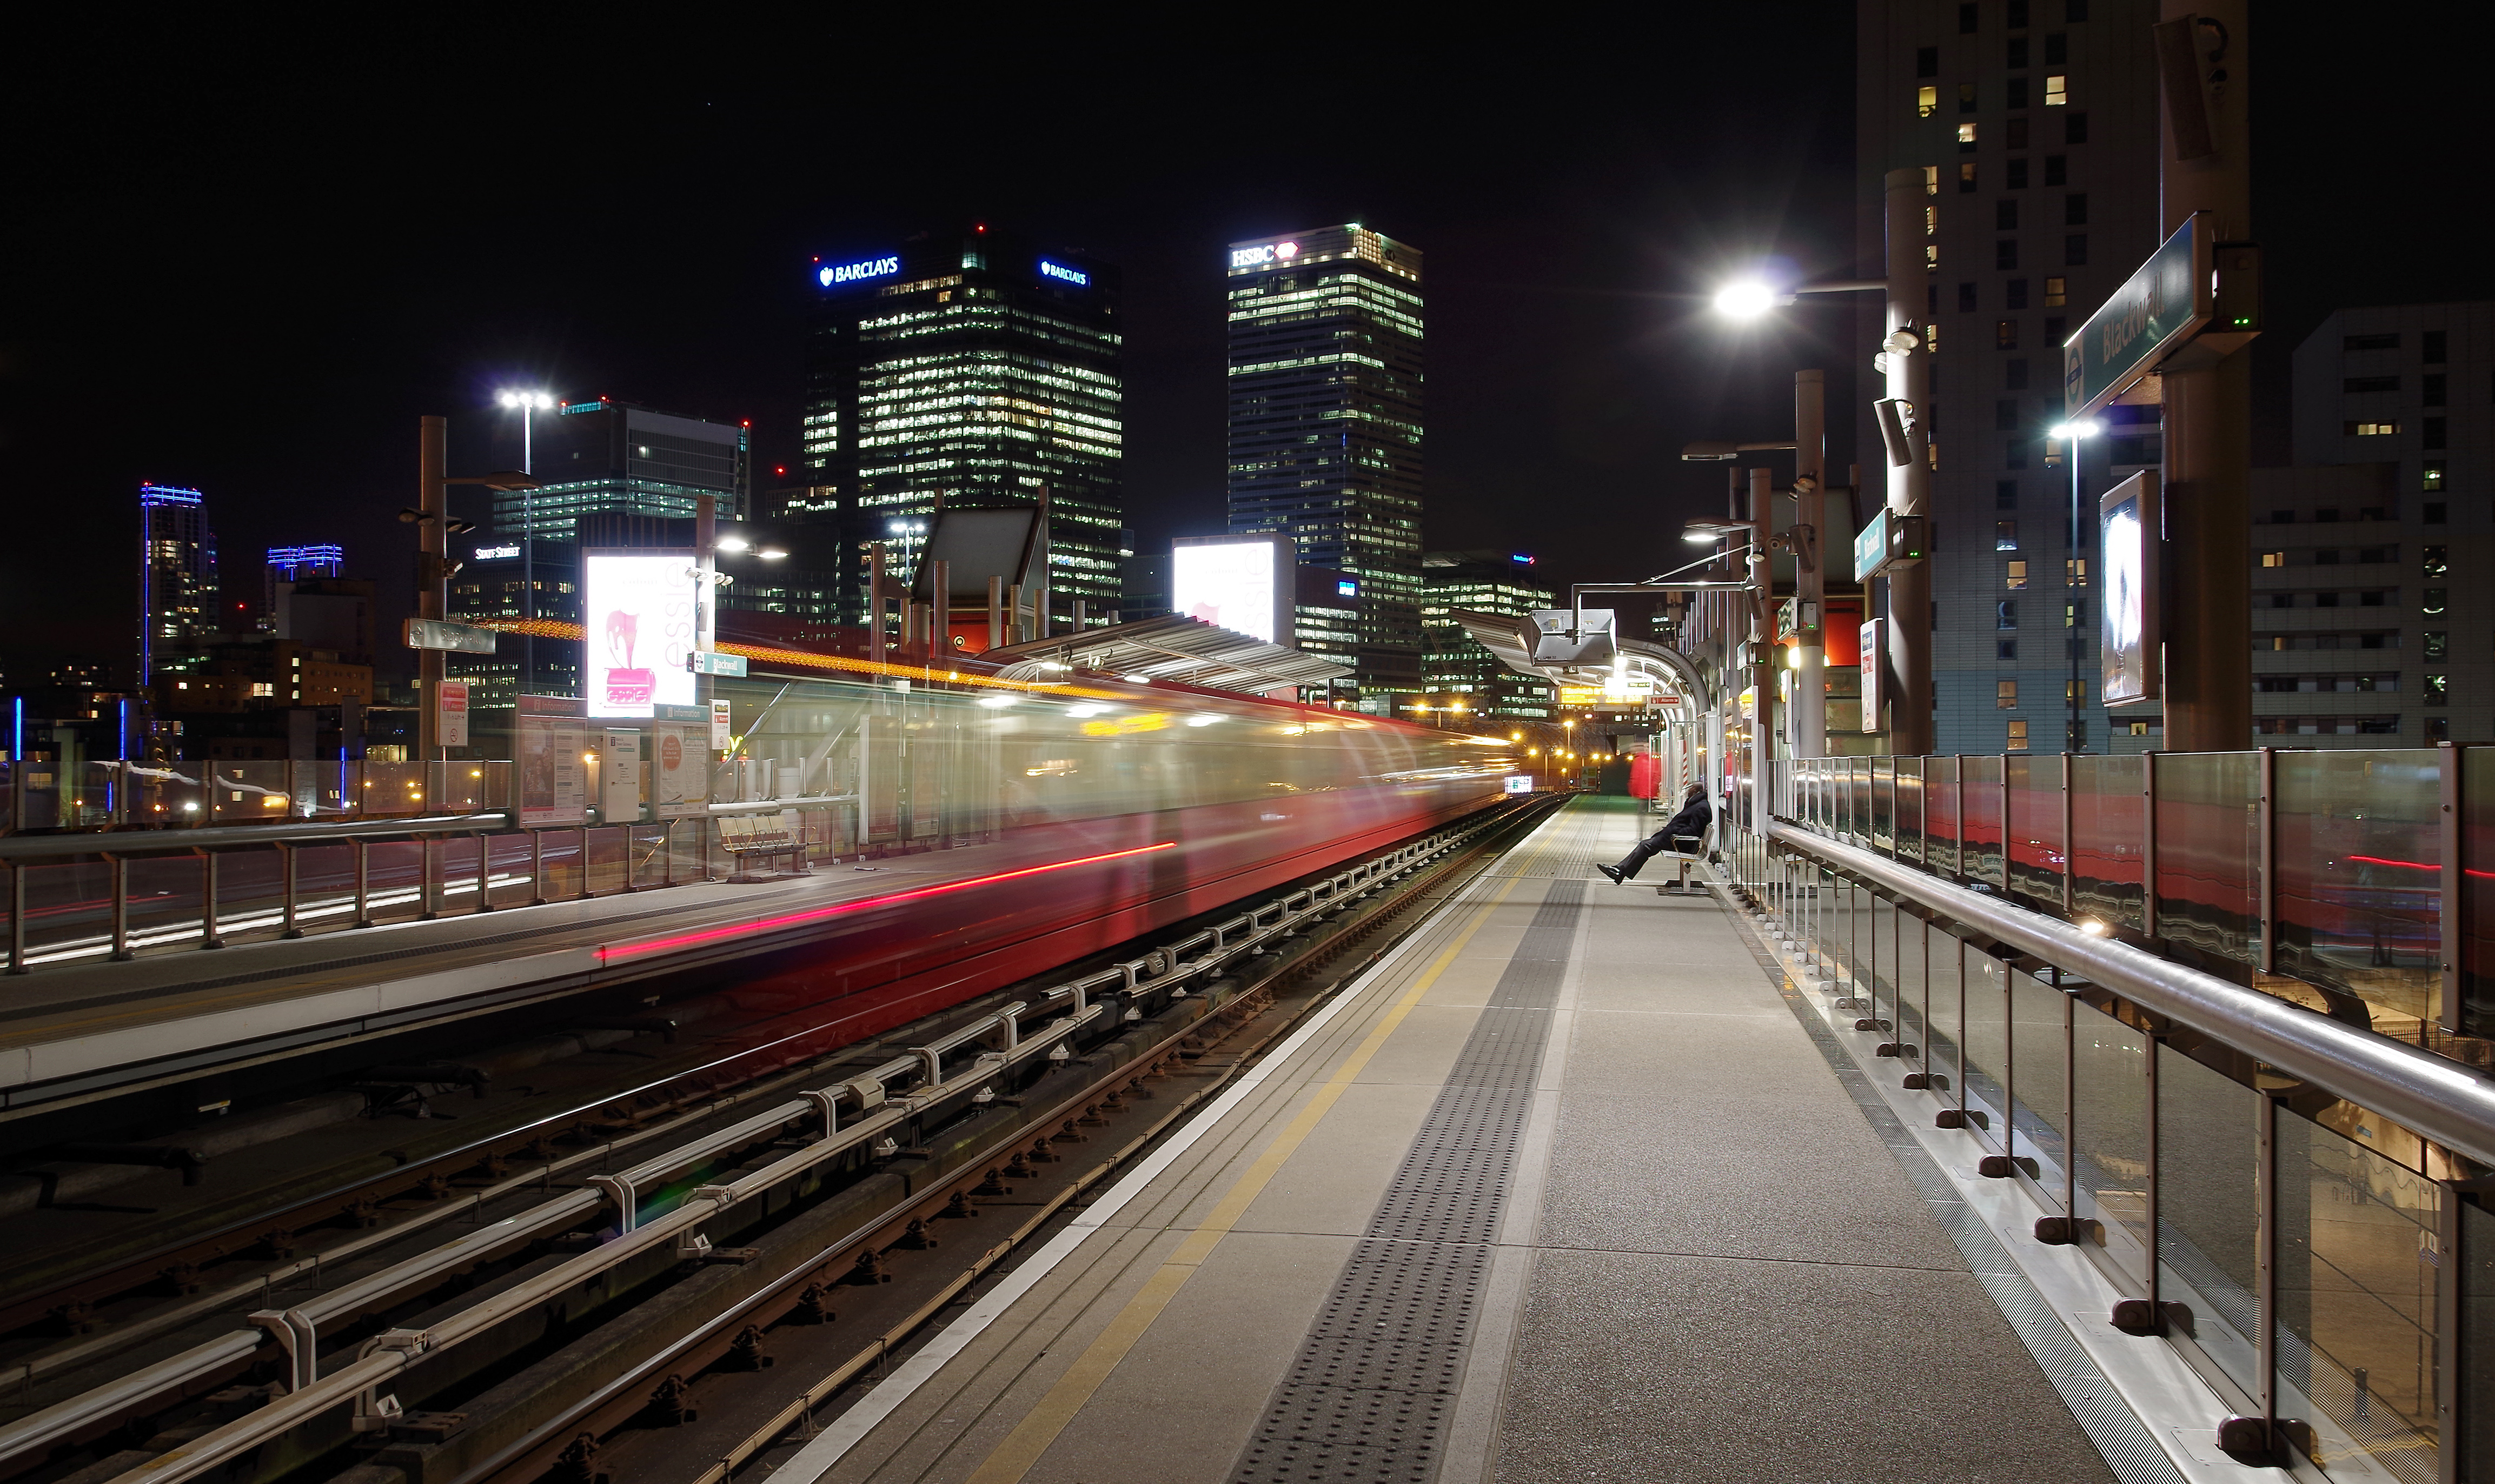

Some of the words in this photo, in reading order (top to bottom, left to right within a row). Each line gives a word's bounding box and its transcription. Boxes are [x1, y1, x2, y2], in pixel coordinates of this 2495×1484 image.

[1232, 244, 1275, 267] HSBC
[835, 256, 898, 283] BARCLAYS
[1050, 264, 1086, 285] BARCLAYS
[2104, 270, 2165, 365] Blackwall
[660, 562, 691, 667] essie
[713, 658, 738, 670] Blackwall
[607, 688, 647, 702] essie
[542, 701, 576, 711] Information
[674, 708, 700, 717] Information
